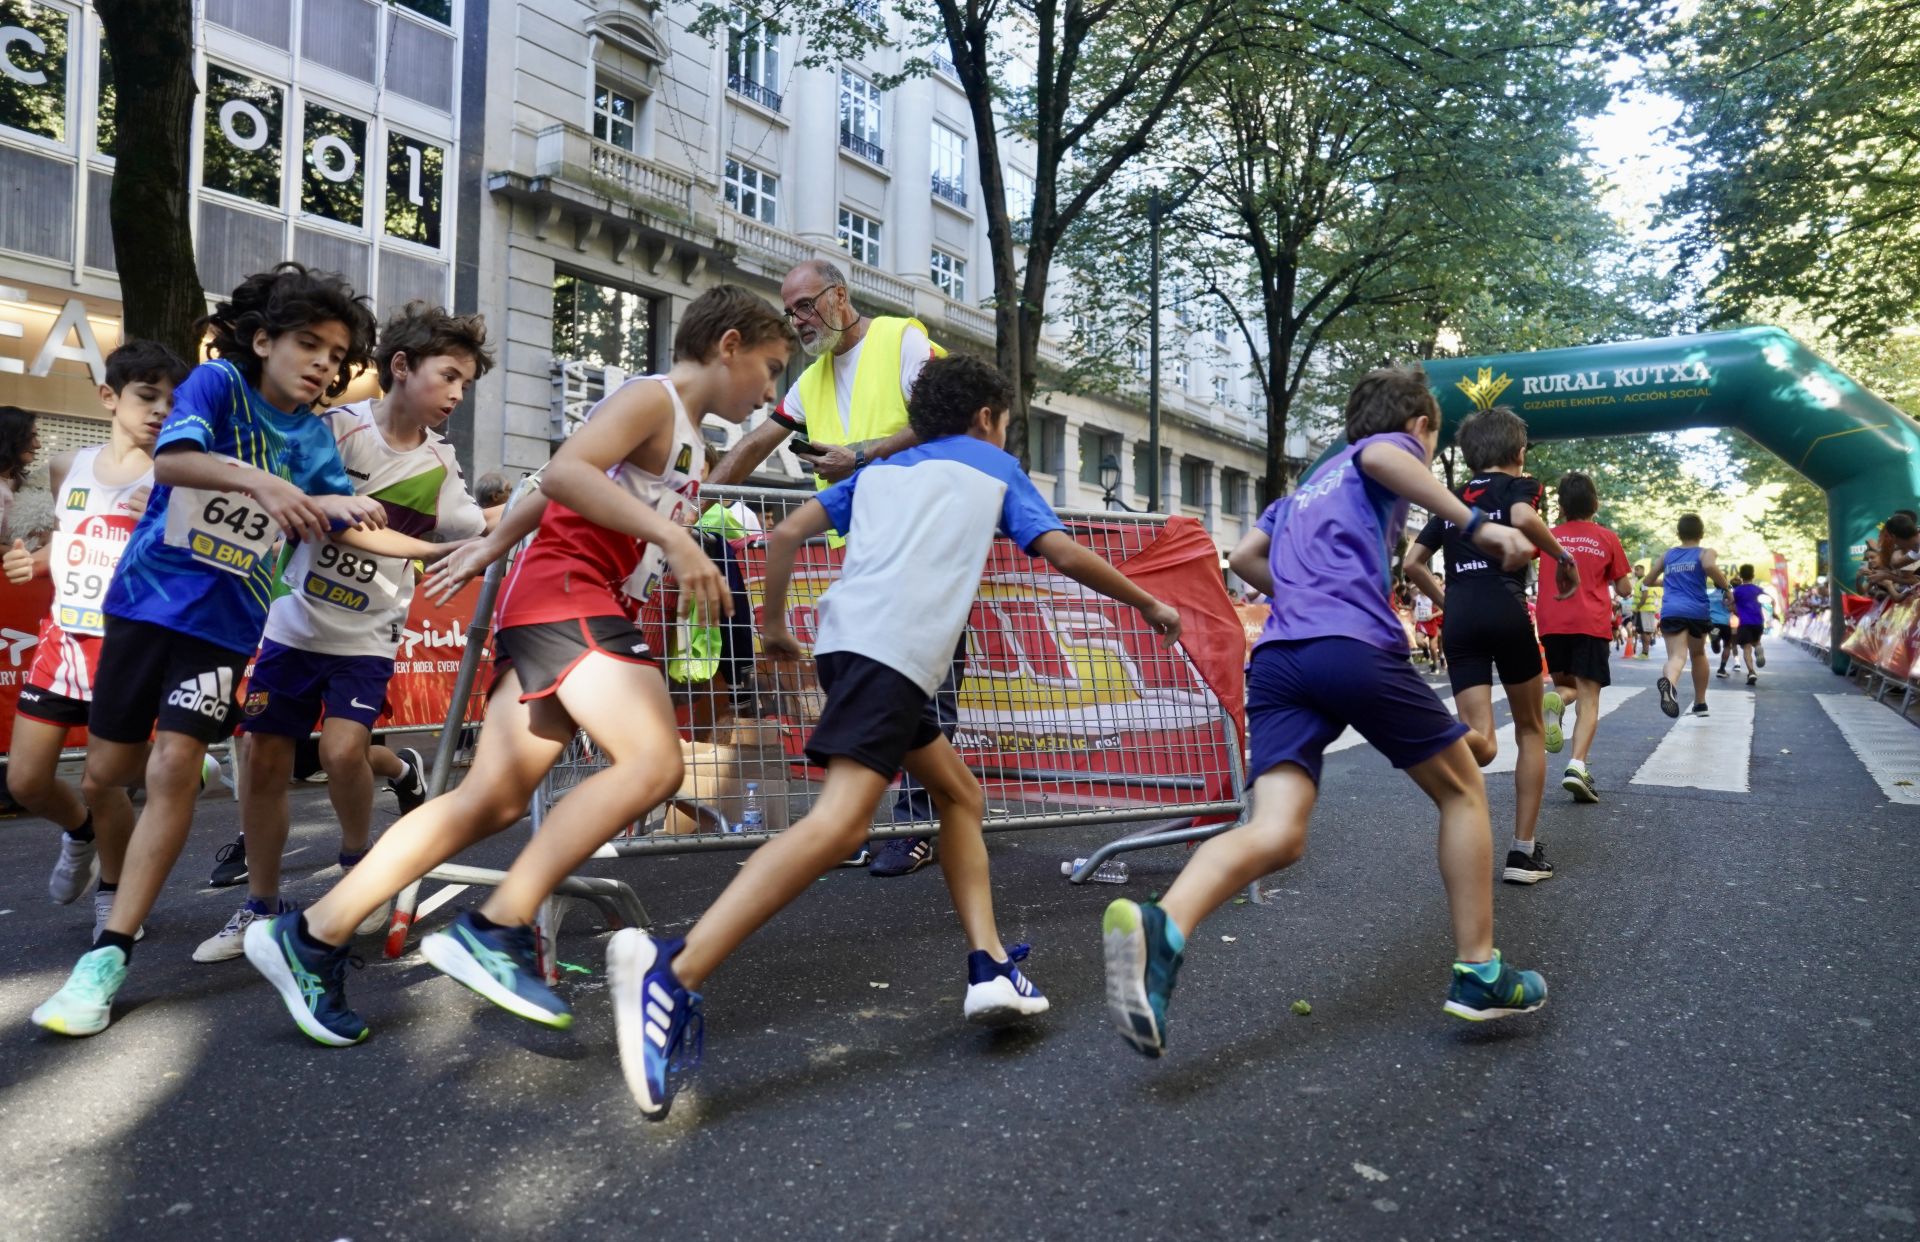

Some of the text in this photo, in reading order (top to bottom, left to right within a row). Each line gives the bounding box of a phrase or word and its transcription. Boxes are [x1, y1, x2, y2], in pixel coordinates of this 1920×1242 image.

[1522, 361, 1711, 395] RURAL KUTXA
[1523, 388, 1711, 411] GIZARTE EKINTZA ACCIÓN SOCIAL
[203, 497, 270, 541] 643
[1556, 536, 1599, 547] ATLETISMO
[216, 543, 254, 570] BM
[317, 544, 378, 583] 989
[63, 571, 112, 599] 59
[327, 586, 364, 609] BM
[437, 660, 461, 672] EVERY
[168, 689, 228, 722] adida
